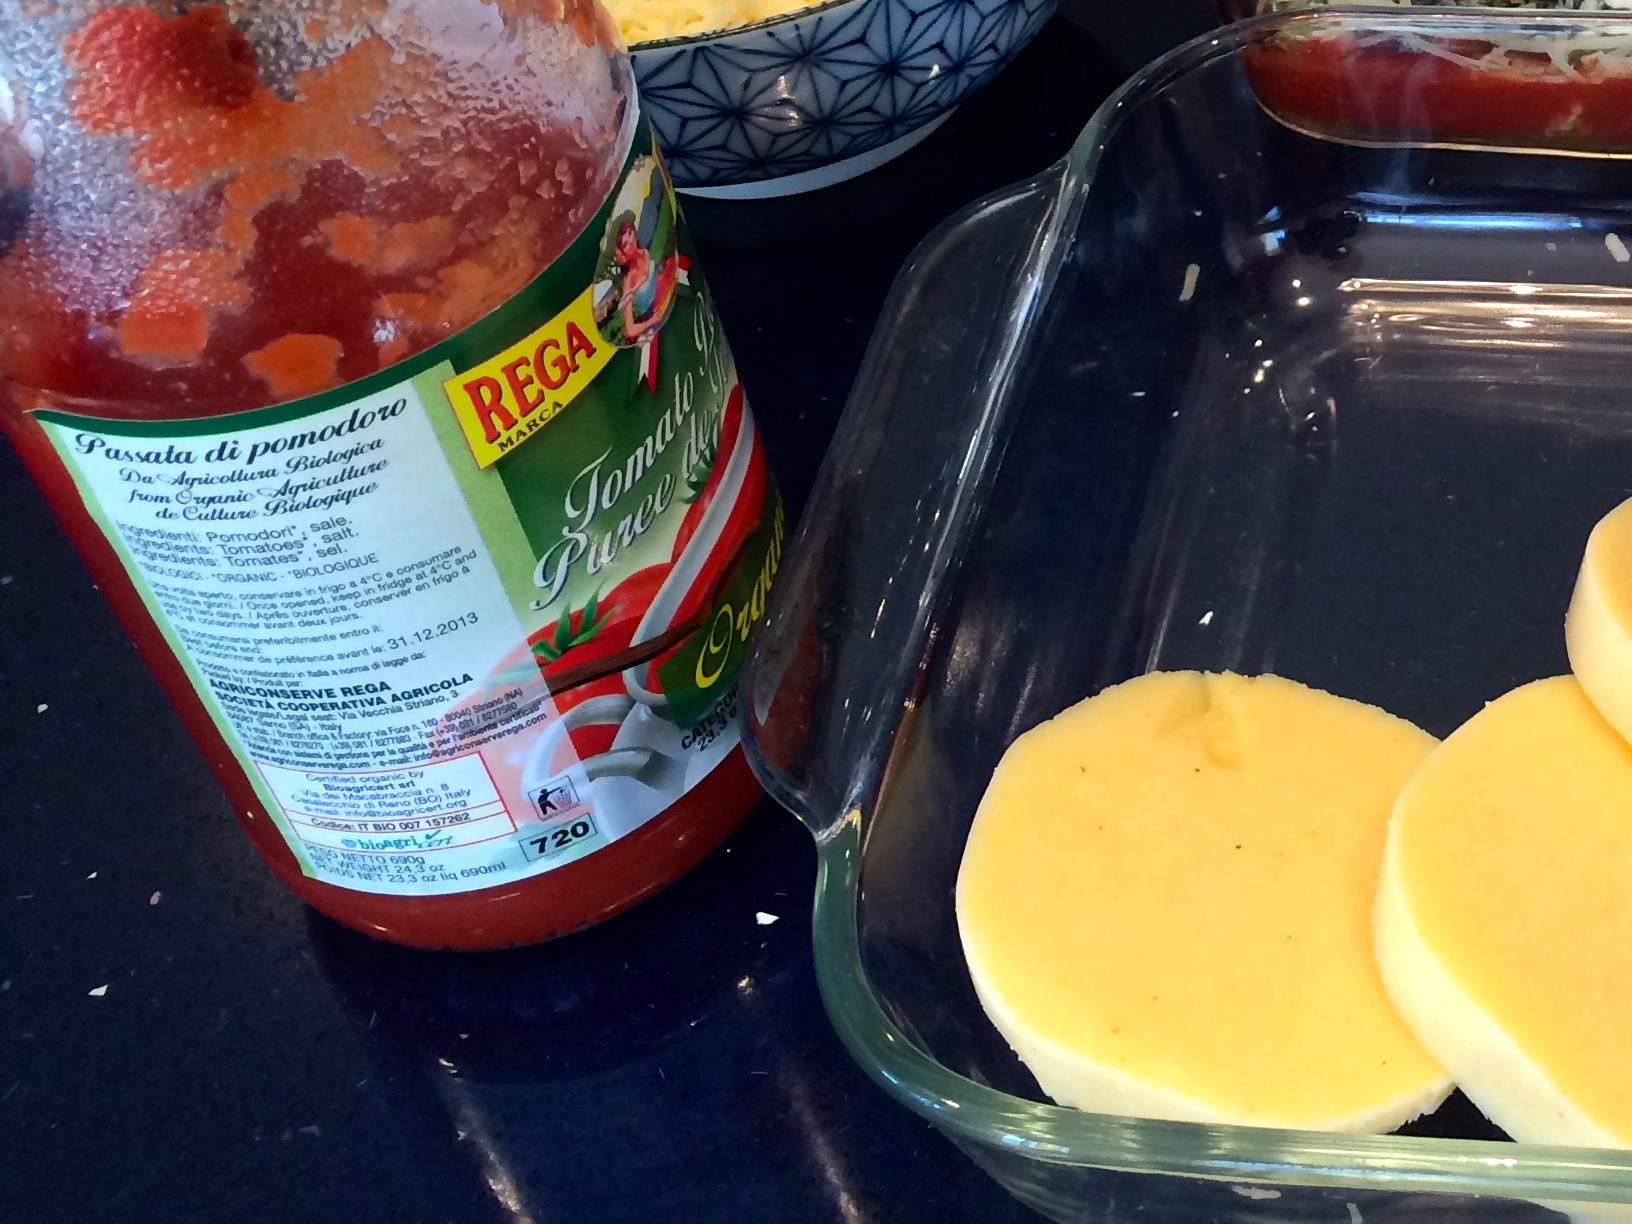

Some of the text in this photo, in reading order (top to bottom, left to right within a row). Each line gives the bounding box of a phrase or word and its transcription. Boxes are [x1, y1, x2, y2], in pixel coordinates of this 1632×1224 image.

[462, 321, 597, 445] REGA
[75, 398, 407, 465] Passata di pomodoro
[496, 400, 564, 452] MARCA
[119, 437, 385, 489] Da Agricoltura Biologica
[561, 370, 694, 537] Tomato
[127, 458, 390, 508] from Organic Agriculture
[155, 480, 379, 521] de Culture Biologique
[309, 516, 353, 534] sale.
[321, 525, 360, 544] salt.
[530, 473, 677, 611] Puree
[315, 543, 348, 560] sel.
[396, 545, 462, 576] consumare
[454, 549, 478, 566] and
[387, 611, 479, 651] 31.12.2013
[209, 677, 338, 700] AGRICONSERVE
[340, 680, 392, 698] REGA
[214, 690, 275, 710] SOCIETÀ
[276, 696, 388, 712] COOPERATIVA
[391, 673, 474, 704] AGRICOLA
[358, 704, 403, 719] Vecchia
[450, 689, 460, 699] 3
[444, 788, 472, 802] Italy
[398, 820, 422, 831] 007
[529, 820, 591, 855] 720
[460, 860, 508, 878] 690ml
